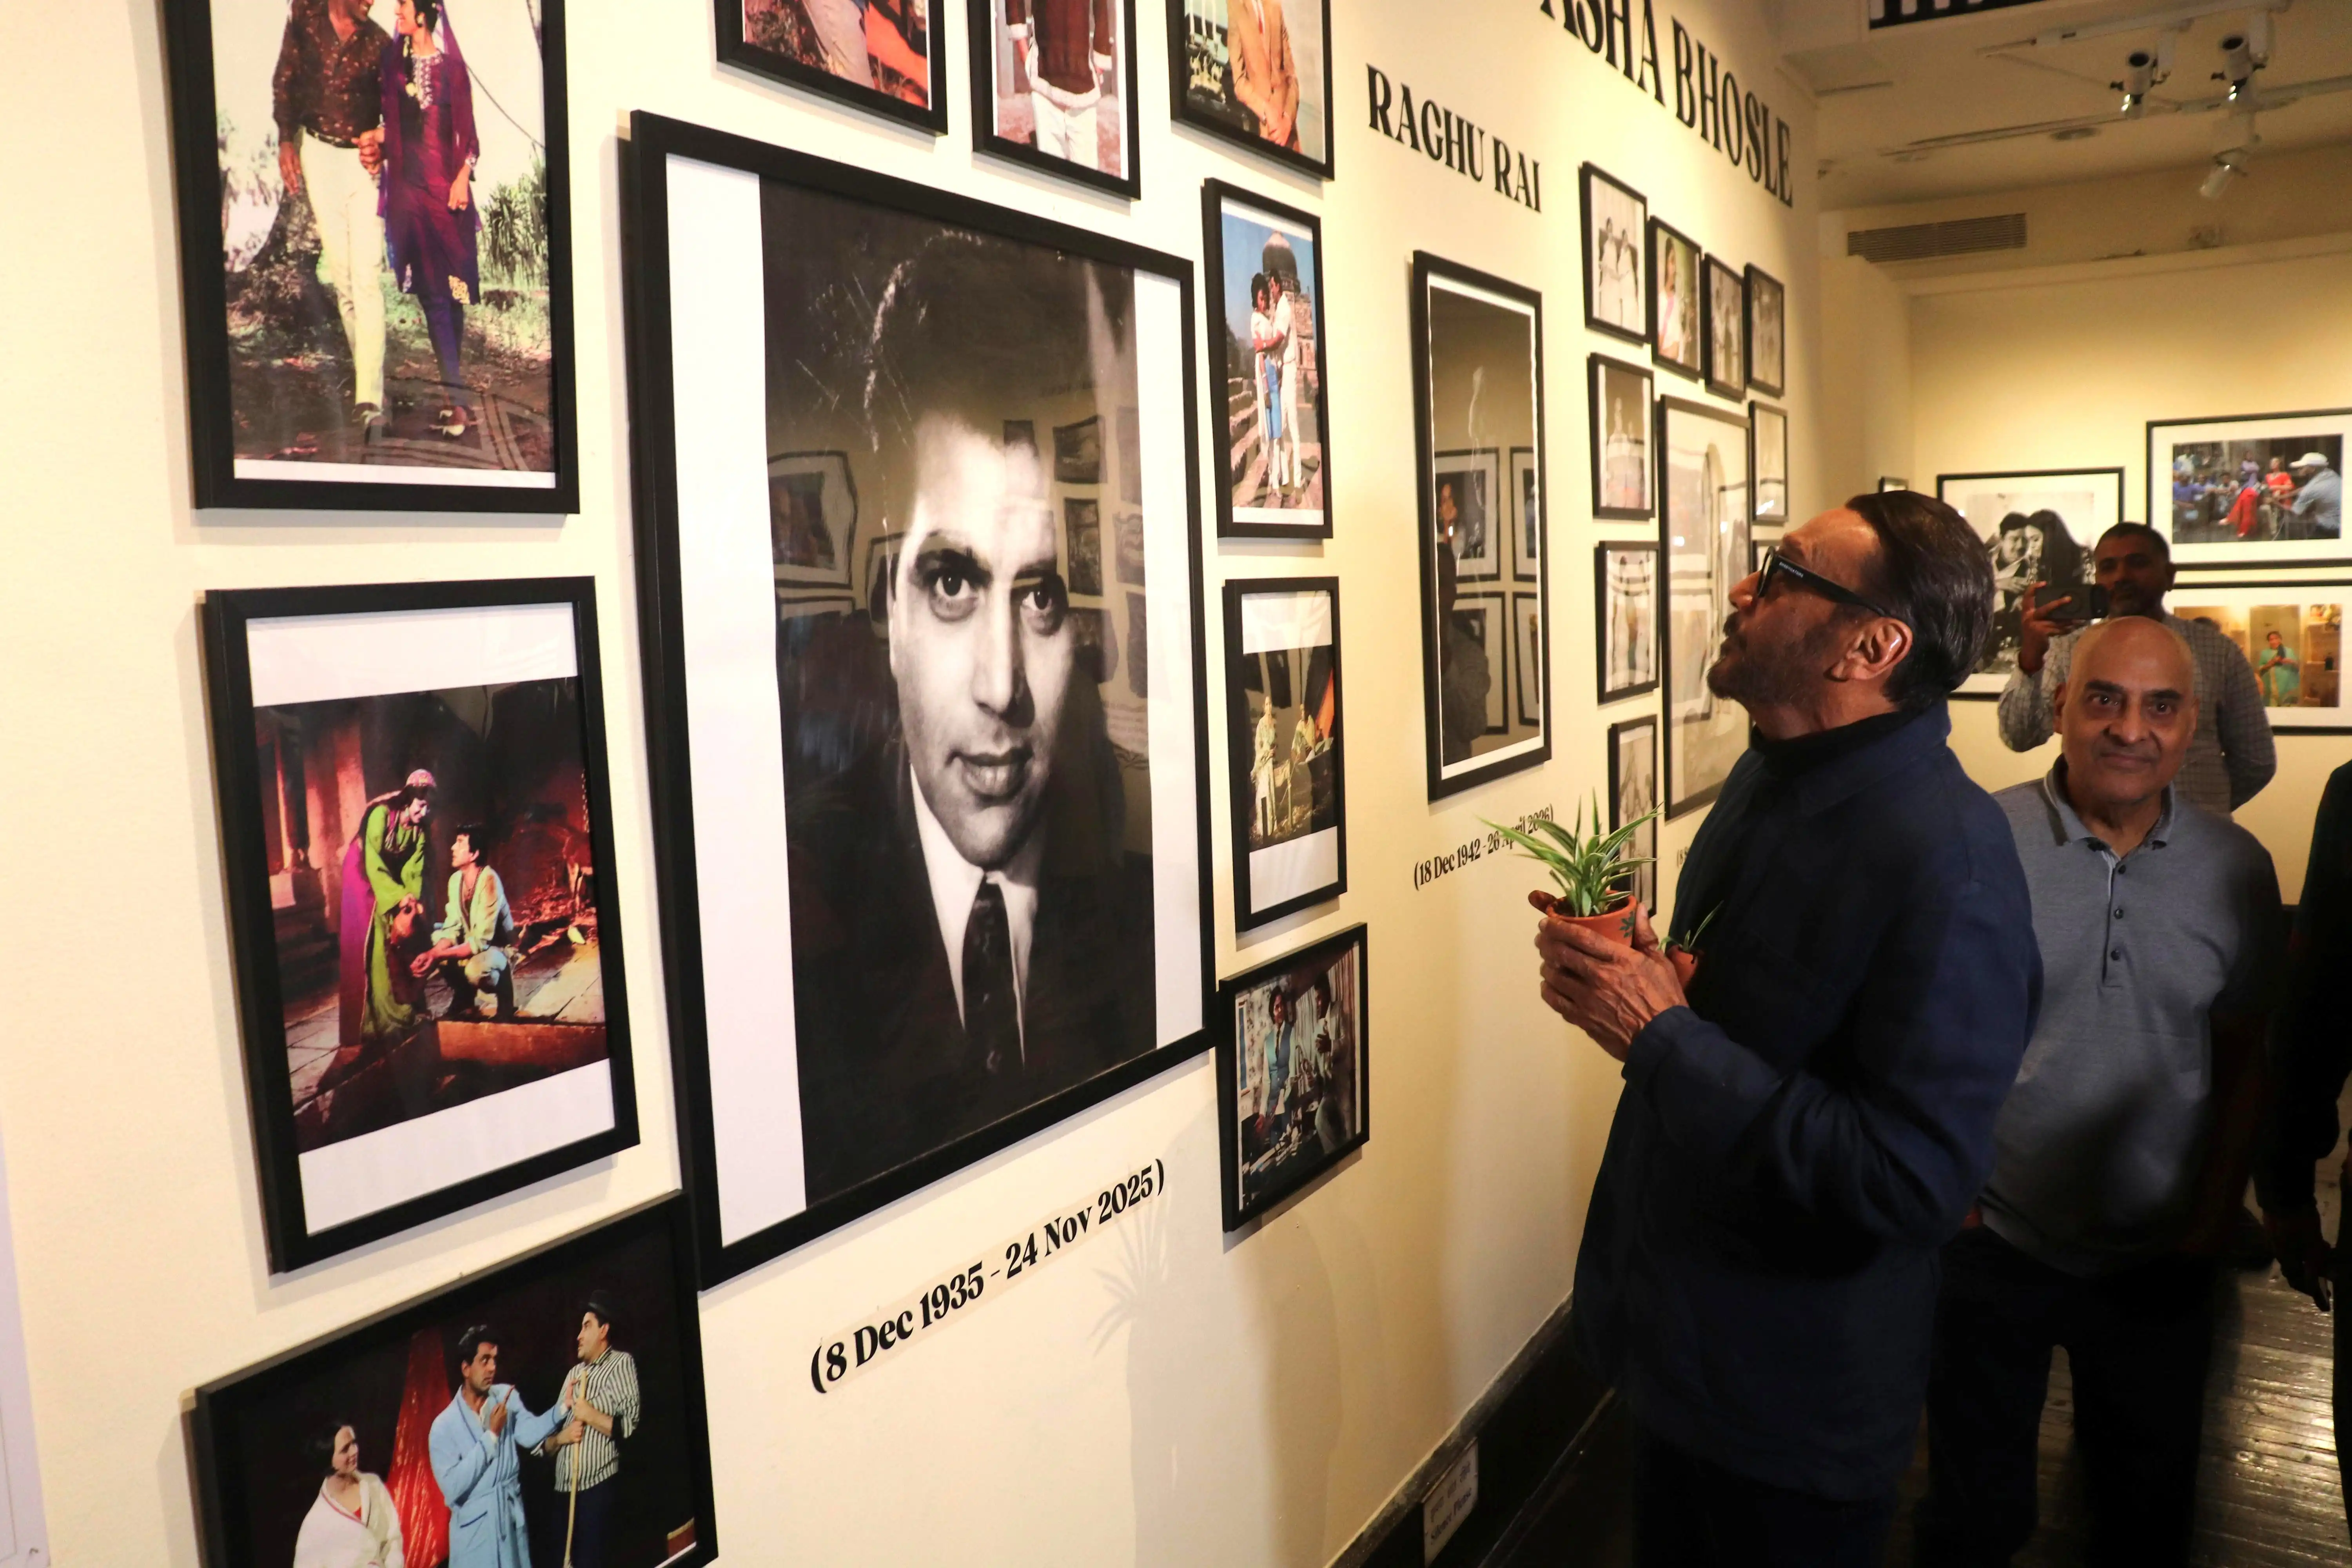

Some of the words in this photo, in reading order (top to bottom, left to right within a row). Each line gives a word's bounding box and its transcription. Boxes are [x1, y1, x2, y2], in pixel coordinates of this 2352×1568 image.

[1366, 63, 1485, 183] RAGHU
[1493, 136, 1541, 214] RAI
[1540, 0, 1666, 107] HA
[1671, 15, 1793, 209] BHOSLE
[1414, 860, 1432, 891] (18
[1434, 854, 1455, 879] Dec
[1457, 838, 1481, 868] 1942
[1488, 830, 1500, 855] 26
[810, 1342, 847, 1394] (8
[853, 1310, 914, 1368] Dec
[919, 1261, 984, 1329] 1935
[1005, 1232, 1038, 1279] 24
[1044, 1206, 1093, 1257] Nov
[1098, 1158, 1165, 1225] 2025)
